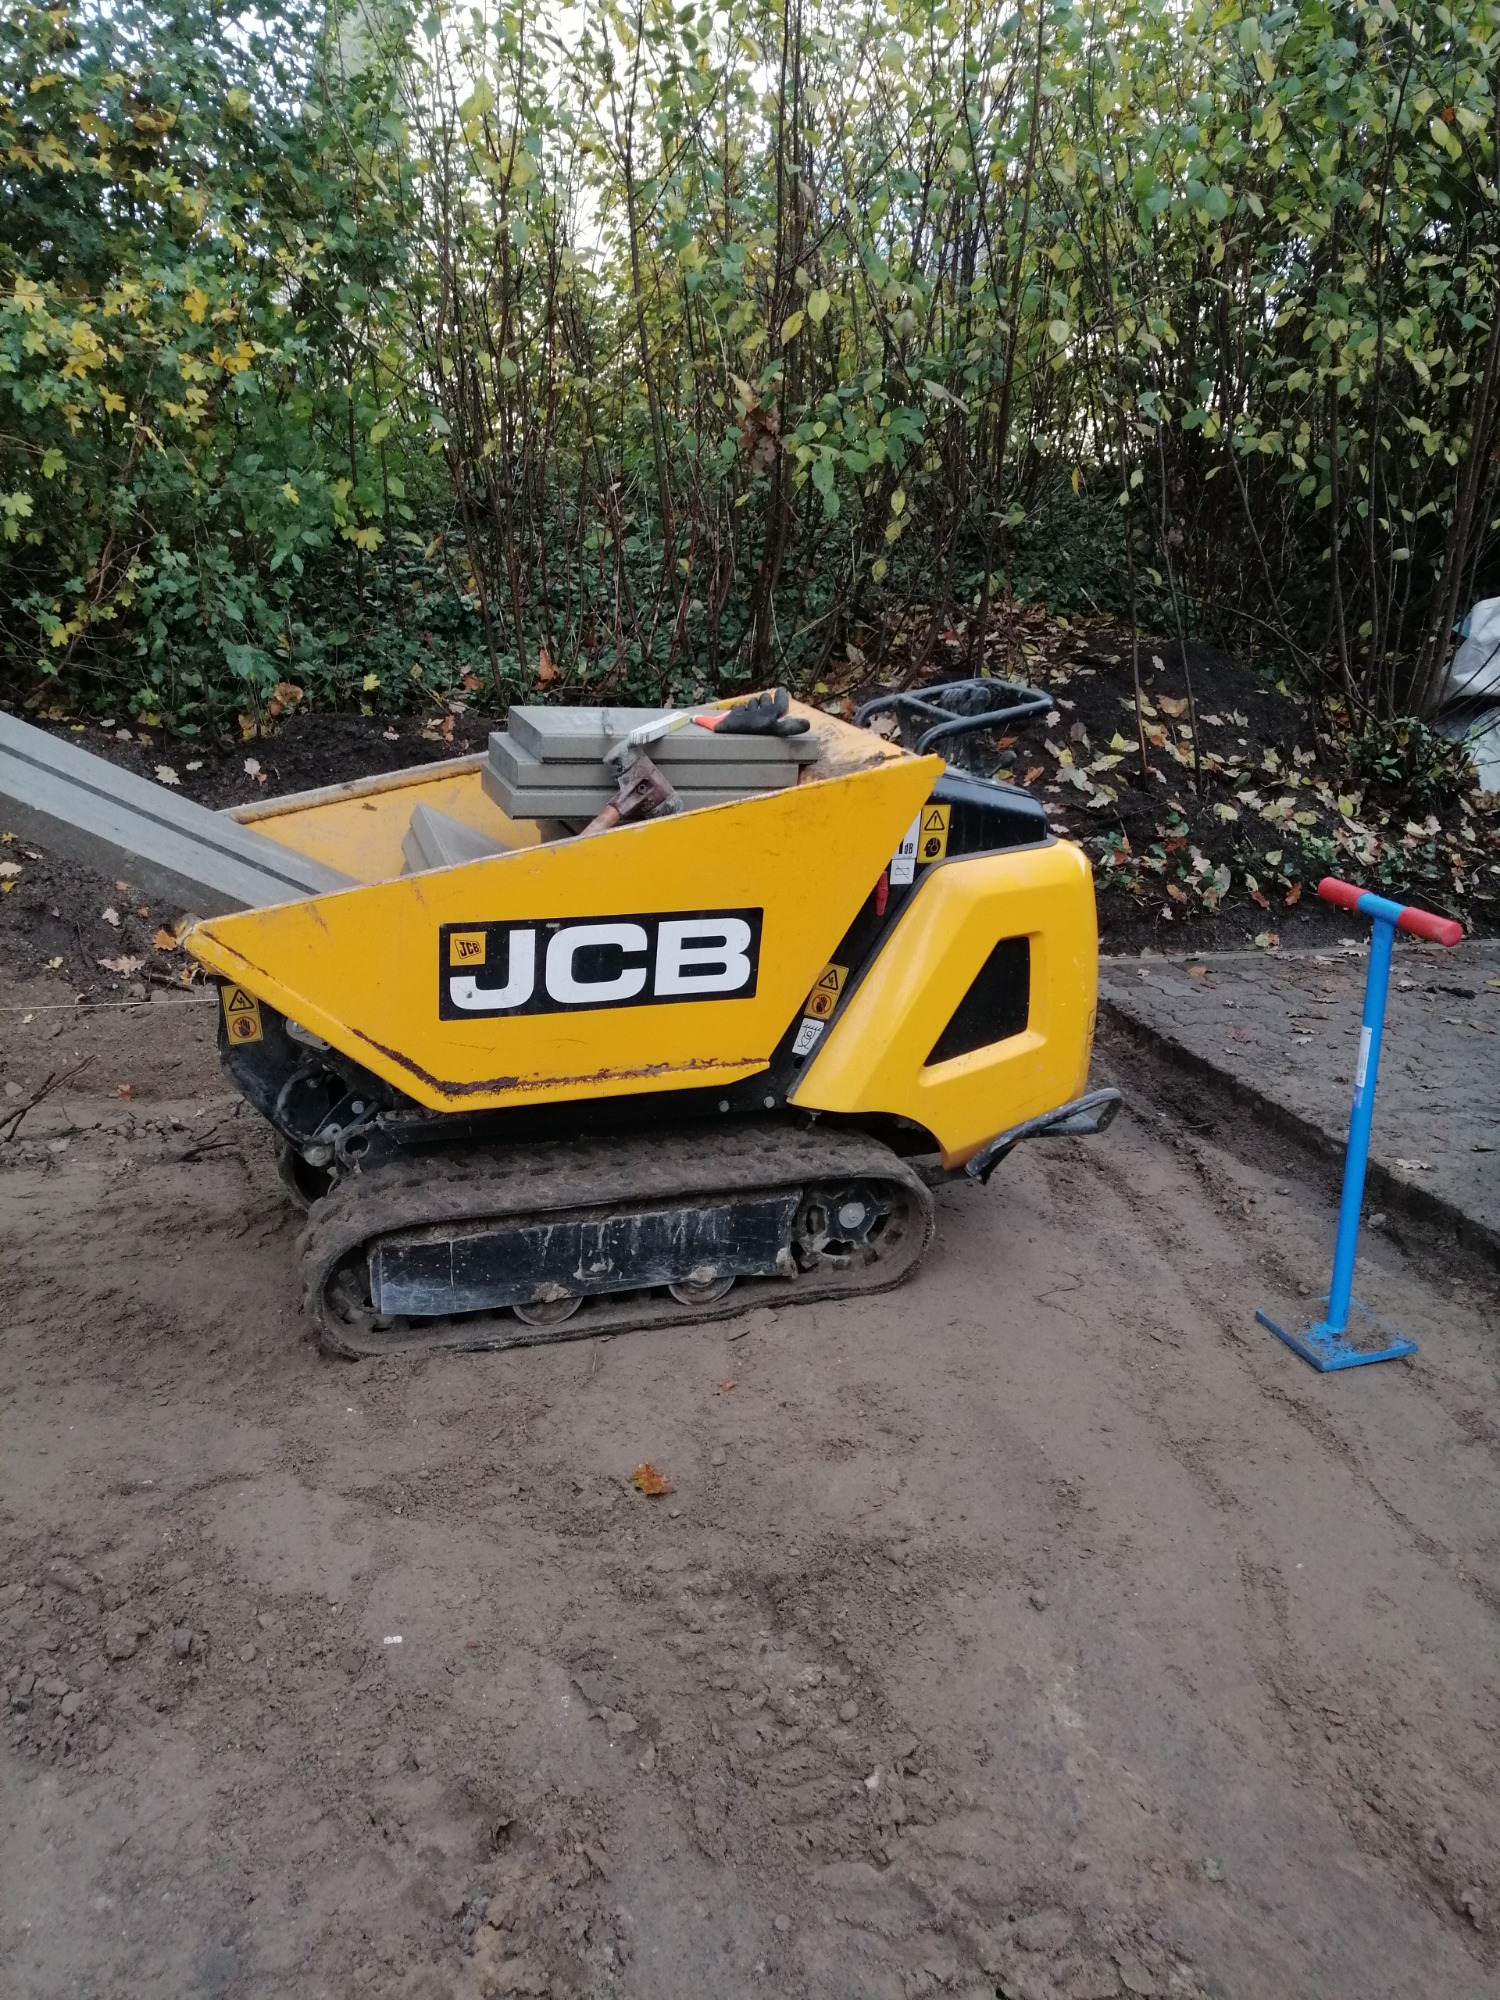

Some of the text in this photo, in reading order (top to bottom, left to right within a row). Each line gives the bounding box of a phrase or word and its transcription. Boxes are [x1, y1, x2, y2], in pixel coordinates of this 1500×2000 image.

[904, 842, 914, 855] dB
[459, 941, 480, 957] JCB
[449, 917, 751, 1010] JCB
